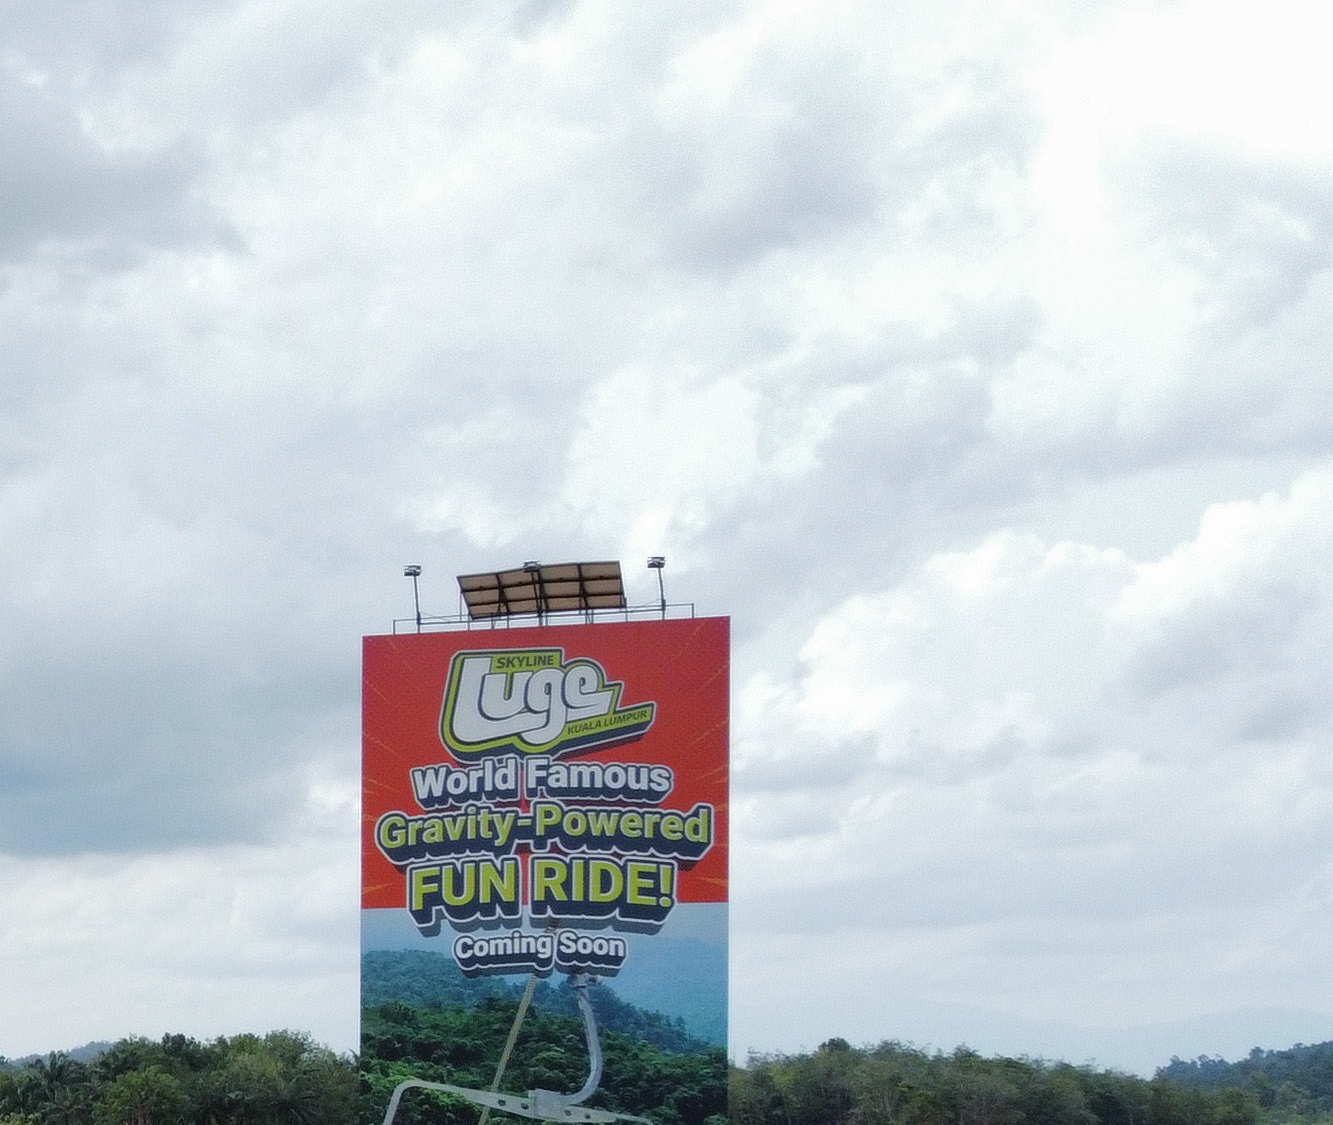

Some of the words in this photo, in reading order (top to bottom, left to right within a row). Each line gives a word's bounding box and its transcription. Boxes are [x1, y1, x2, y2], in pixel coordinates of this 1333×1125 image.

[496, 654, 555, 669] SKYLINE
[452, 657, 614, 745] Luge
[567, 719, 602, 736] KUALA
[603, 709, 648, 728] LUMPUR
[414, 758, 516, 800] World
[526, 757, 672, 792] Famous
[381, 804, 710, 848] Gravity-Powered
[411, 861, 517, 911] FUN
[532, 860, 675, 908] RIDE!
[455, 932, 552, 961] Coming
[559, 935, 625, 958] Soon
